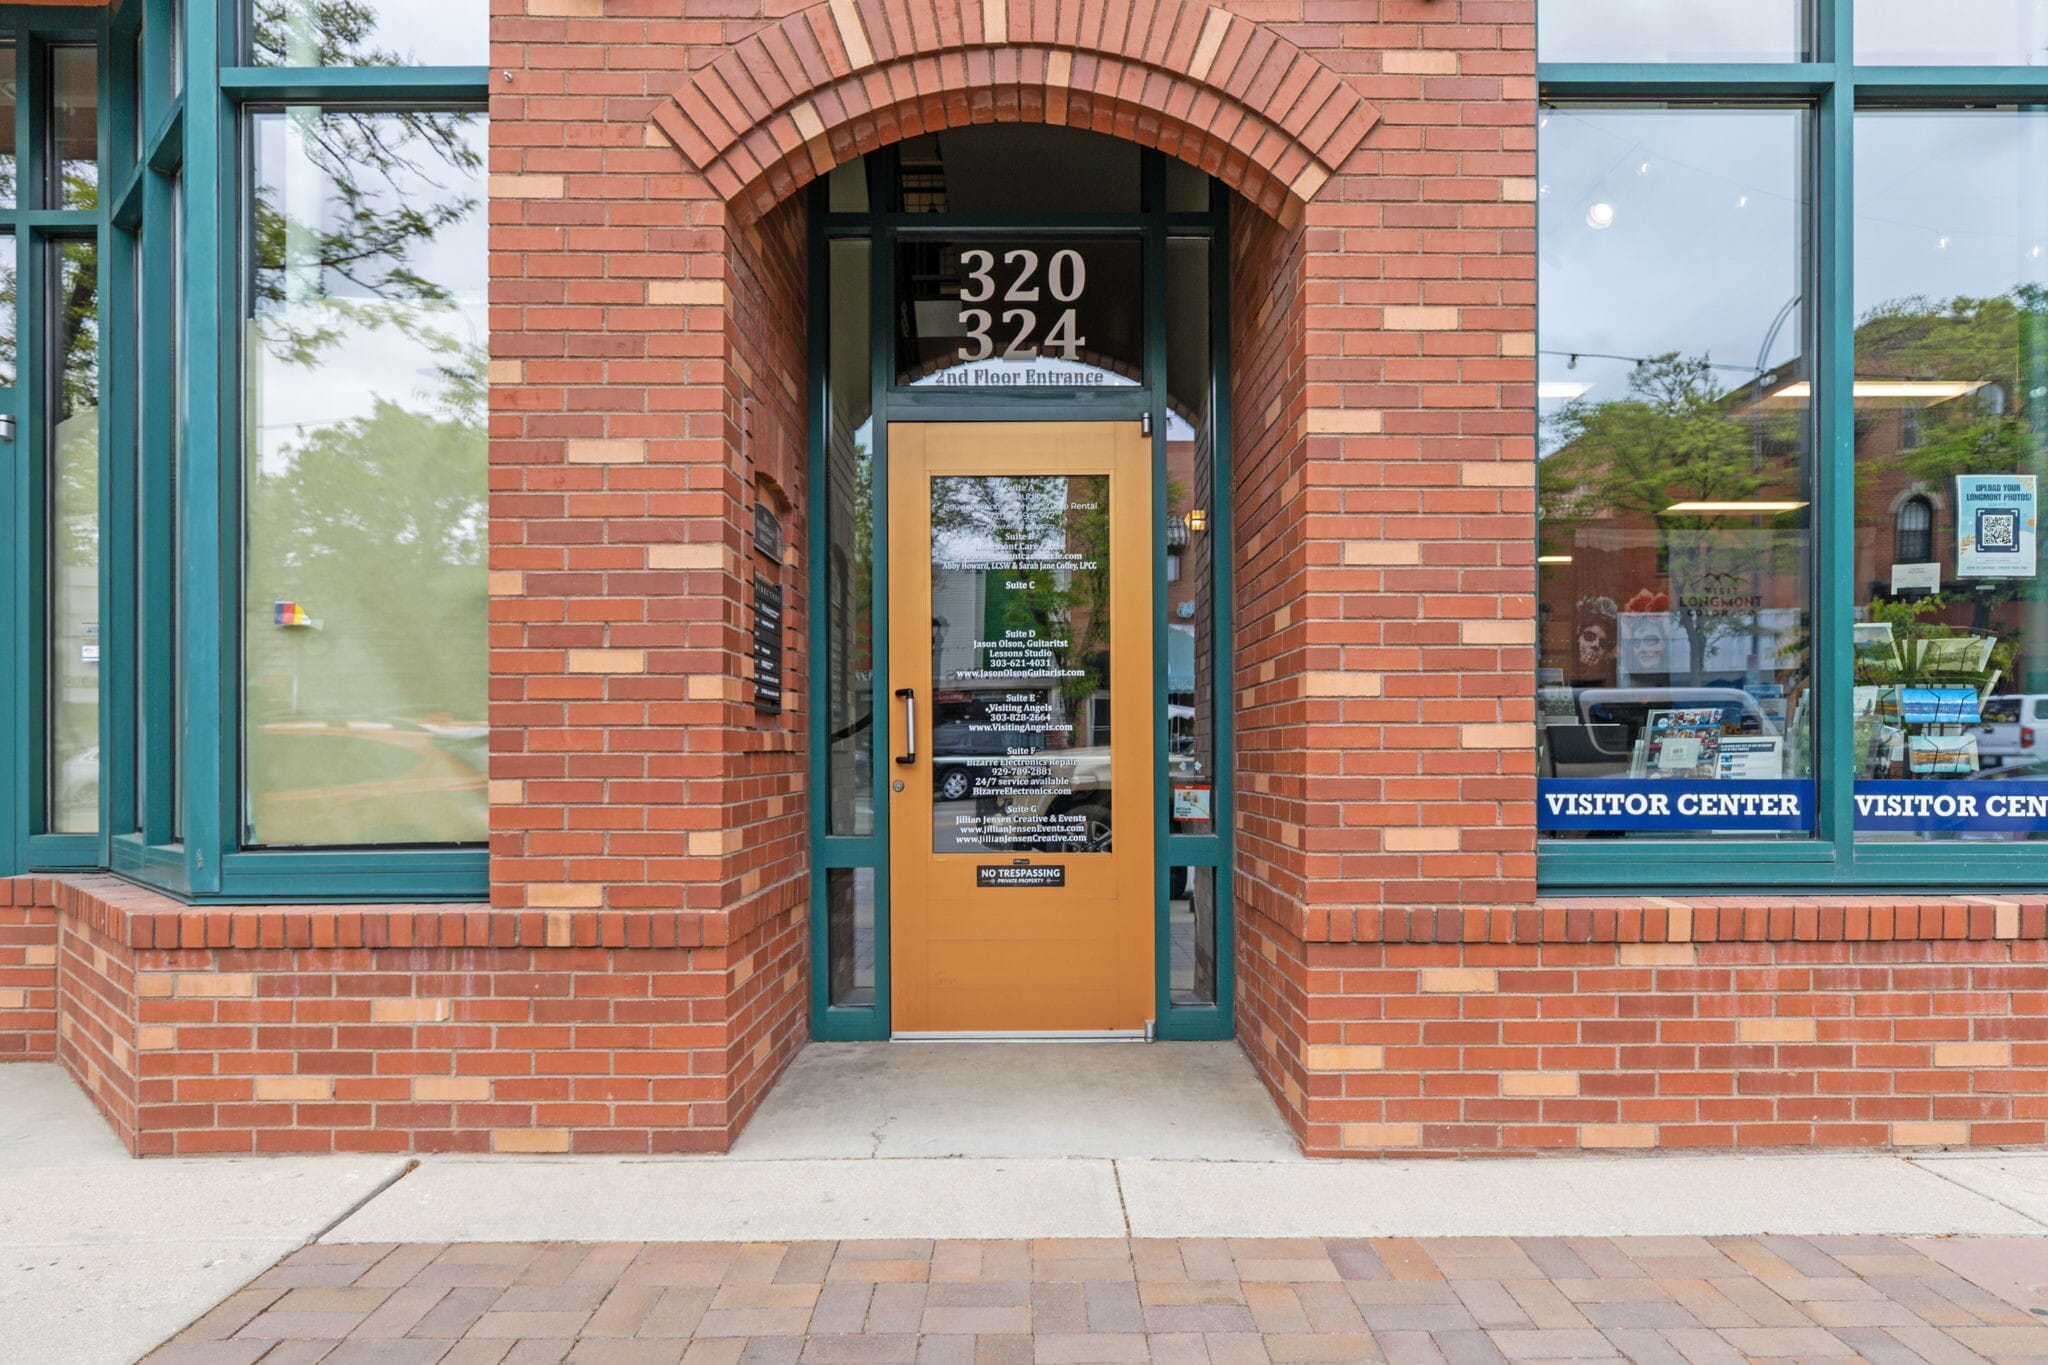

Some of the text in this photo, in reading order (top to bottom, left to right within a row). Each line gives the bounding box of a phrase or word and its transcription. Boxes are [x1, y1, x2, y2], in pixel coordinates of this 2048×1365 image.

[960, 249, 1086, 302] 320
[958, 308, 1086, 362] 324
[935, 368, 1104, 385] 2nd Floor Entrance
[1975, 483, 2021, 492] UPLOAD YOUR
[1966, 493, 2032, 502] LONGMONT PHOTOS!
[1070, 502, 1098, 510] Rental
[1005, 532, 1026, 541] Suite
[942, 561, 961, 571] Abby
[961, 561, 991, 571] Howard,
[991, 561, 1010, 570] LCSW
[1019, 561, 1039, 570] Sarah
[1040, 561, 1055, 571] Jane
[1079, 561, 1098, 570] LPCC
[1005, 581, 1036, 590] Suite C
[1704, 587, 1738, 595] VISIT
[1679, 596, 1763, 608] LONGMONT
[1005, 629, 1036, 638] Suite D
[973, 639, 997, 649] Jason
[998, 639, 1025, 649] Olson,
[989, 649, 1053, 658] Lessons Studio
[990, 659, 1051, 667] 303-621-4031
[1005, 693, 1036, 703] Suite E
[989, 703, 1053, 714] Visiting Angels
[990, 713, 1051, 722] 303-828-2664
[968, 723, 1073, 733] www.VisitingAngels.com
[1006, 746, 1036, 756] Suite F
[966, 758, 1078, 768] Bizarre Electronics Repair
[975, 777, 1069, 787] 24/7 service available
[973, 787, 1072, 796] BizarreElectronics.com
[1006, 804, 1037, 814] Suite G
[1545, 793, 1801, 816] VISITOR CENTER
[1854, 795, 2048, 817] VISITOR CEN
[956, 814, 1087, 825] Jillian Jensen Creative & Events
[981, 868, 1061, 878] NO TRESPASSING
